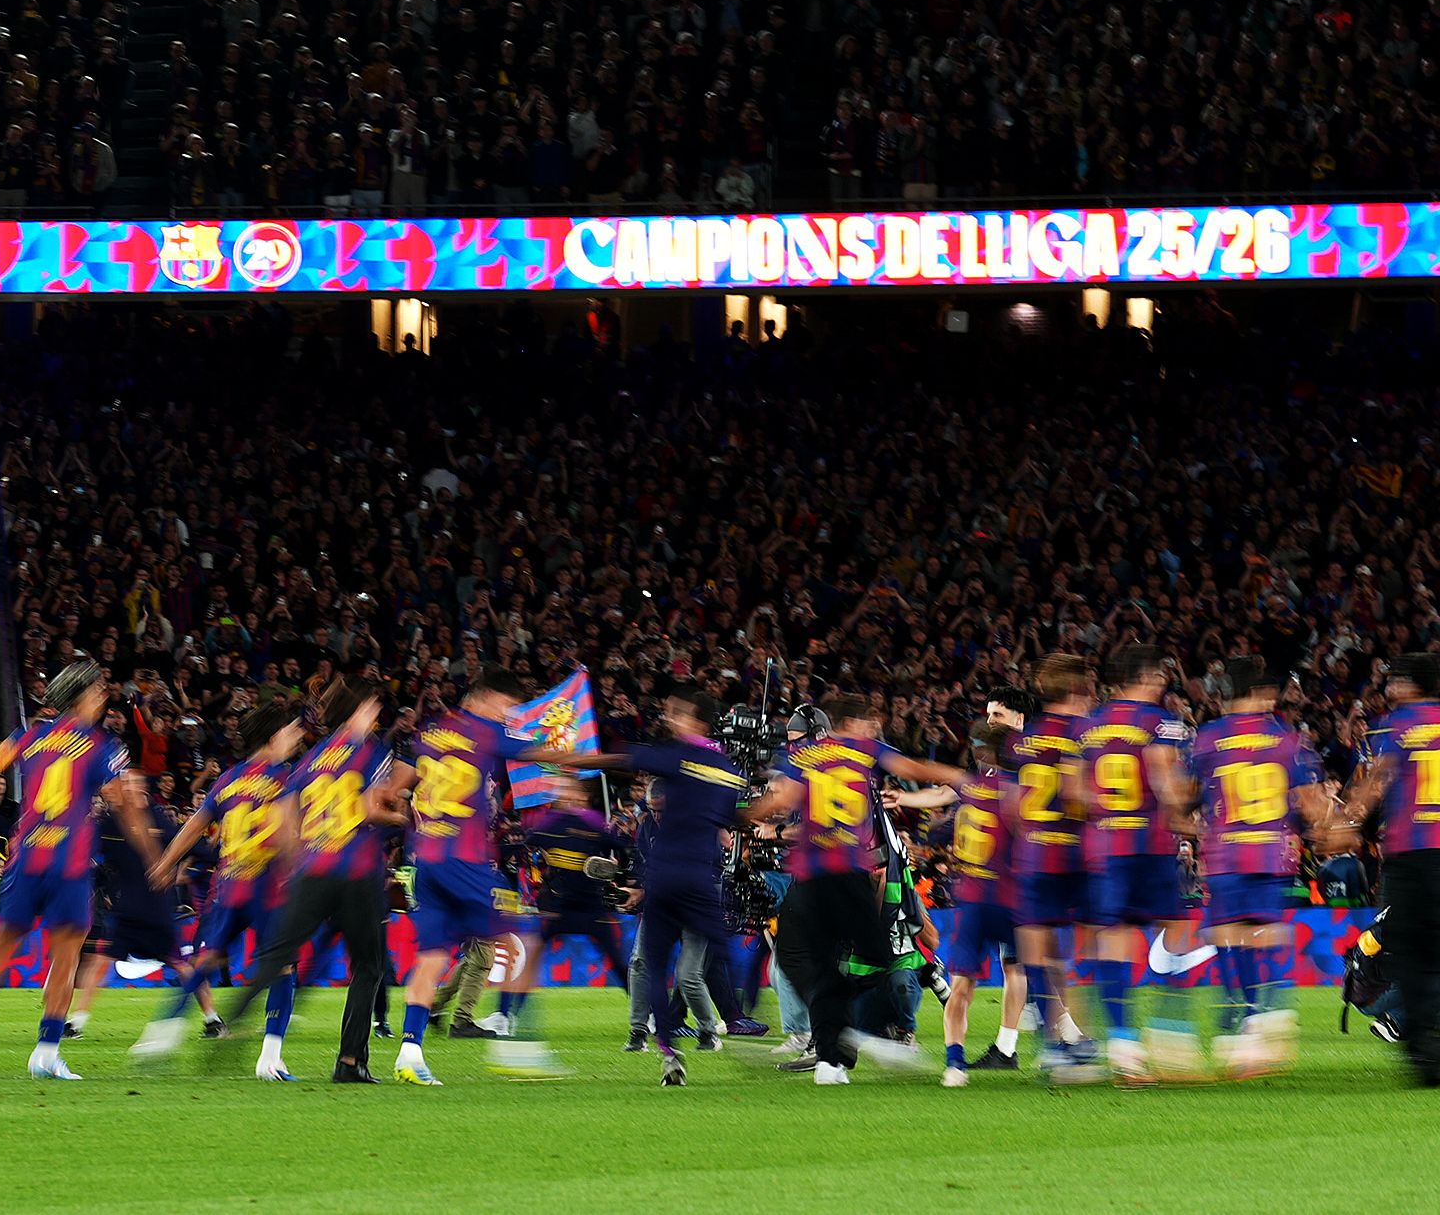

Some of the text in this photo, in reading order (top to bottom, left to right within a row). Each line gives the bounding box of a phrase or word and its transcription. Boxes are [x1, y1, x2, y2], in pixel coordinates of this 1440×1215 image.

[563, 209, 1291, 282] CAMPIONS DE LLIGA 25/26
[1094, 752, 1144, 812] 9
[953, 803, 1000, 865] 6
